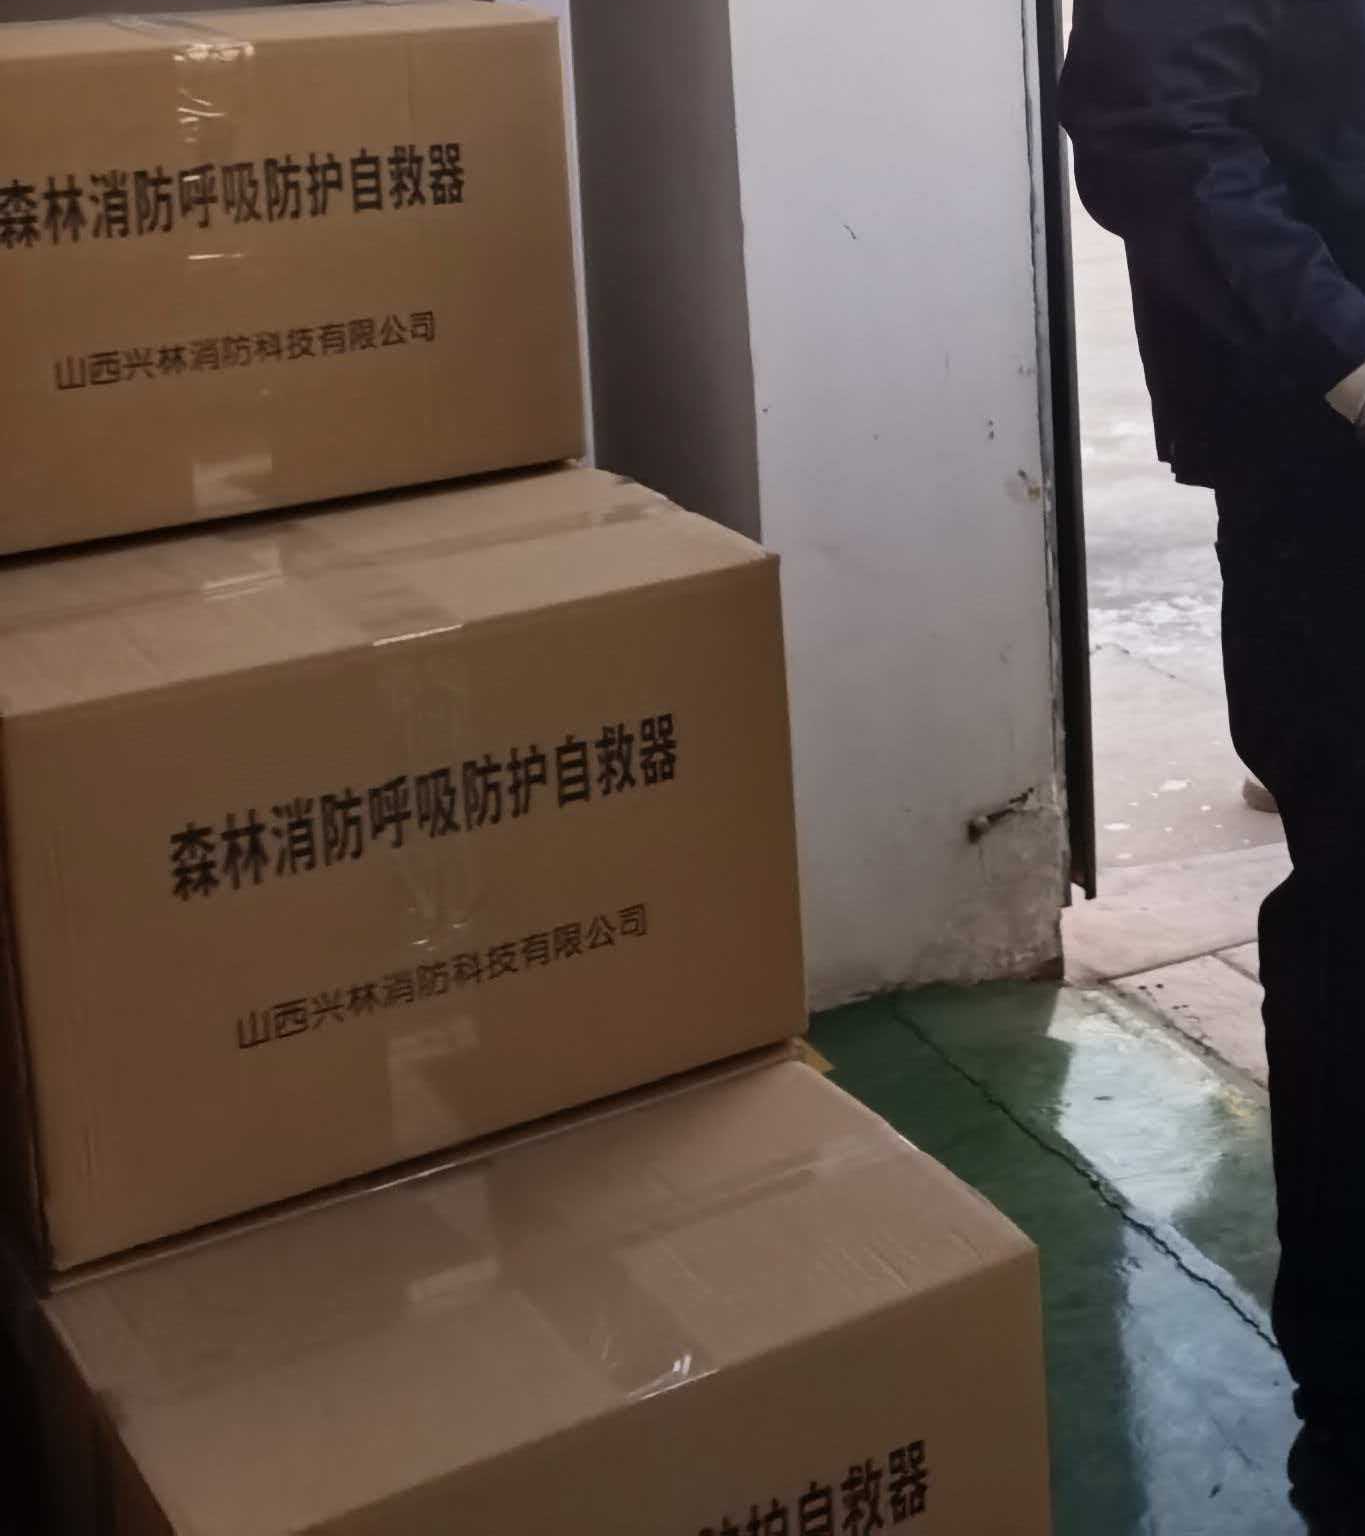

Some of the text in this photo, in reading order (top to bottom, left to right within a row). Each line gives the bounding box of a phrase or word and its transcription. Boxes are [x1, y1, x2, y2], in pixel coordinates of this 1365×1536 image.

[0, 143, 465, 249] 森林消防呼吸防护自救器
[55, 310, 437, 392] 山西兴林消防科技有限公司
[168, 712, 679, 902] 森林消防呼吸防护自救器
[236, 902, 649, 1050] 山西兴林消防科技有限公司
